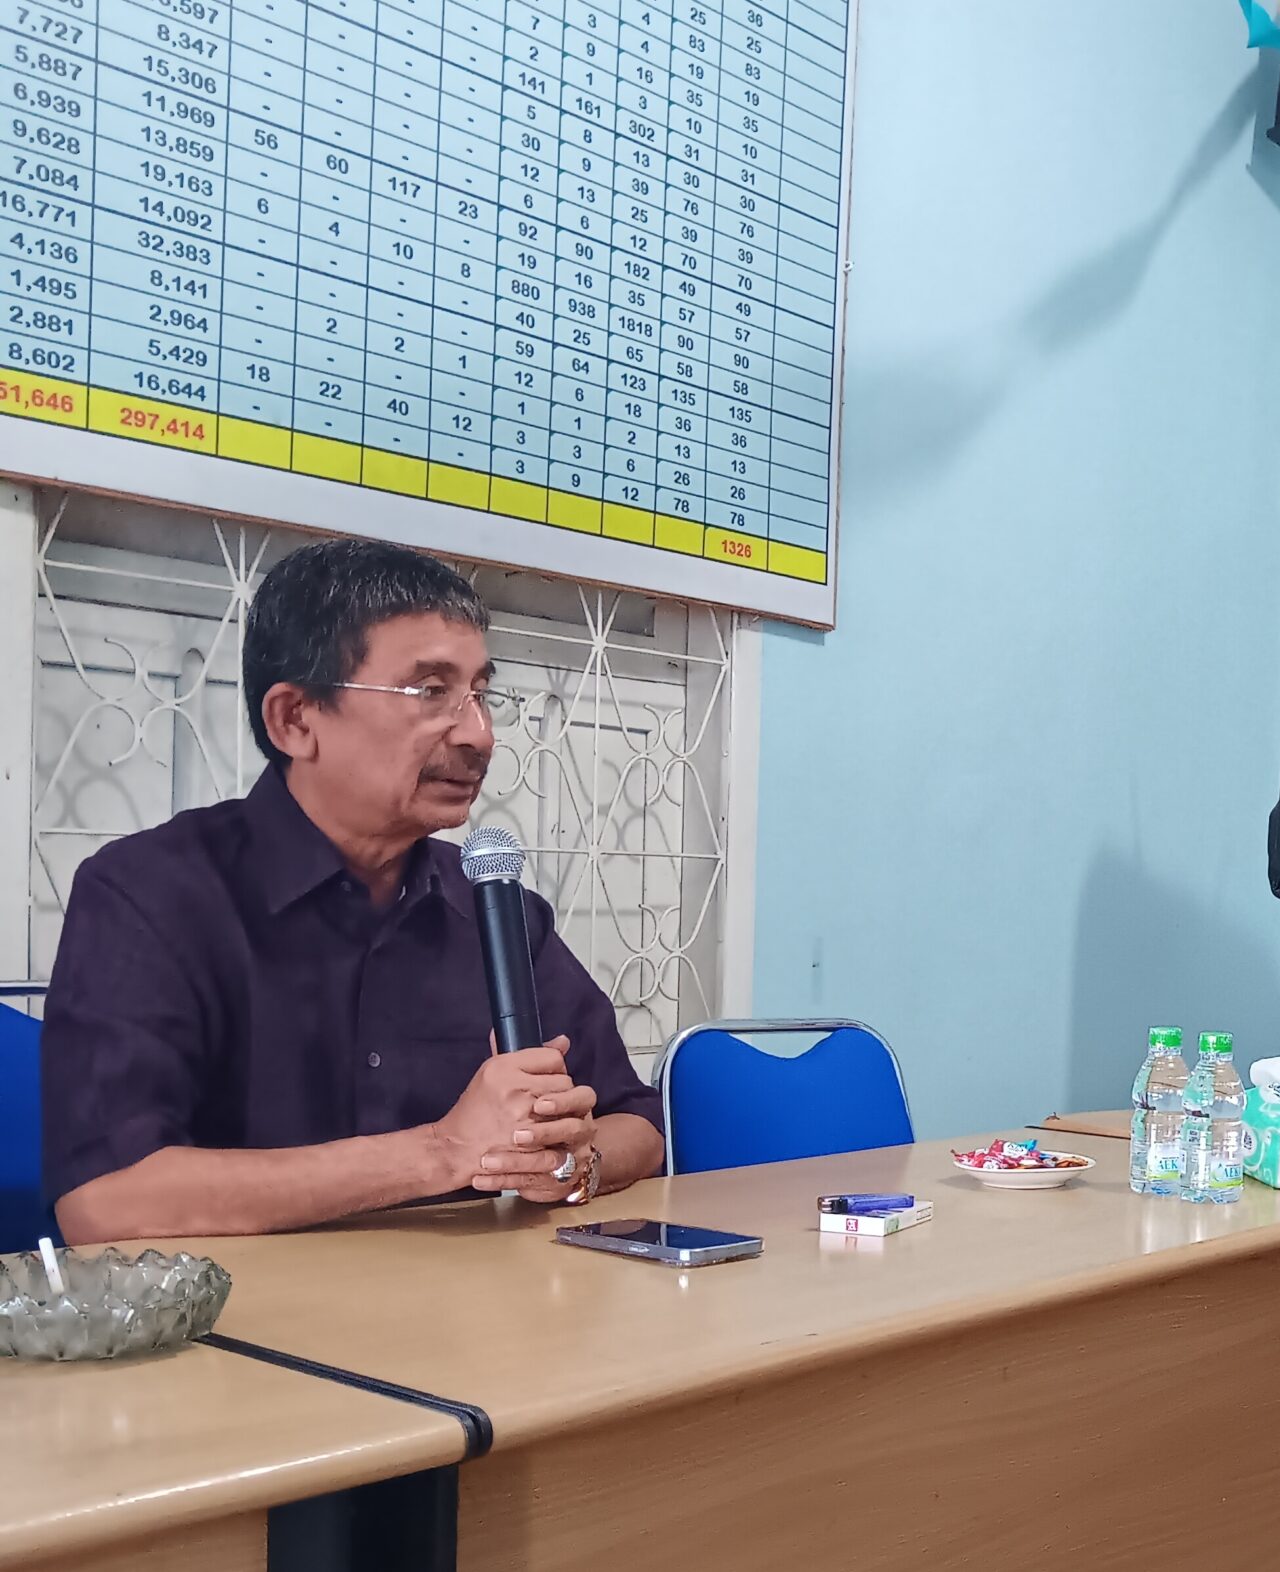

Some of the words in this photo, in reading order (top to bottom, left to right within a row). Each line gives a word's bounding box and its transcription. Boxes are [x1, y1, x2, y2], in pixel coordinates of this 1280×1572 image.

[529, 45, 539, 62] 2
[585, 71, 593, 87] 1
[638, 95, 648, 110] 3
[685, 117, 703, 135] 10
[741, 143, 758, 160] 10
[531, 15, 541, 31] 7
[586, 41, 596, 58] 9
[636, 66, 654, 84] 16
[686, 88, 704, 108] 35
[742, 115, 759, 133] 35
[587, 13, 597, 29] 3
[640, 40, 650, 54] 4
[688, 62, 705, 80] 19
[744, 90, 760, 107] 19
[641, 12, 651, 26] 4
[688, 33, 706, 53] 83
[744, 62, 761, 81] 83
[690, 6, 707, 26] 25
[746, 36, 762, 54] 25
[747, 9, 764, 28] 36
[13, 82, 81, 118] 6,939
[140, 125, 215, 163] 13,859
[517, 252, 537, 270] 19
[574, 271, 593, 290] 16
[627, 289, 646, 307] 35
[678, 306, 696, 324] 57
[734, 326, 751, 343] 57
[14, 44, 83, 81] 5,887
[141, 90, 216, 129] 11,969
[253, 128, 279, 151] 56
[325, 153, 349, 175] 60
[387, 176, 421, 199] 117
[457, 200, 479, 220] 23
[518, 221, 538, 242] 92
[575, 242, 594, 261] 90
[624, 260, 650, 282] 182
[678, 280, 696, 297] 49
[735, 301, 752, 317] 49
[16, 6, 84, 45] 7,727
[142, 55, 217, 95] 15,306
[523, 193, 534, 209] 6
[580, 215, 590, 230] 6
[629, 234, 648, 253] 12
[680, 252, 698, 271] 70
[737, 273, 753, 291] 70
[156, 23, 219, 59] 8,347
[520, 163, 540, 183] 12
[577, 185, 596, 204] 13
[630, 205, 649, 224] 25
[681, 225, 698, 243] 39
[737, 247, 754, 265] 39
[518, 71, 546, 95] 141
[575, 96, 601, 119] 161
[628, 119, 656, 143] 302
[683, 143, 700, 162] 31
[740, 168, 755, 186] 31
[520, 132, 541, 152] 30
[581, 157, 592, 173] 9
[631, 177, 650, 196] 39
[682, 197, 699, 216] 76
[739, 221, 755, 239] 76
[526, 104, 537, 121] 5
[582, 128, 593, 144] 8
[632, 150, 651, 168] 13
[683, 171, 700, 189] 30
[739, 194, 756, 213] 30
[0, 190, 76, 228] 16,771
[137, 230, 212, 266] 32,383
[515, 340, 535, 359] 59
[571, 357, 590, 375] 64
[620, 372, 647, 392] 123
[671, 388, 696, 407] 135
[728, 405, 753, 424] 135
[12, 118, 81, 155] 9,628
[139, 160, 214, 197] 19,163
[256, 197, 269, 215] 6
[327, 221, 341, 238] 4
[392, 241, 414, 260] 10
[460, 262, 471, 279] 8
[510, 279, 541, 301] 880
[567, 298, 596, 319] 938
[618, 315, 653, 338] 1818
[677, 334, 694, 352] 90
[733, 353, 750, 370] 90
[12, 155, 80, 192] 7,084
[138, 196, 213, 233] 14,092
[515, 311, 536, 329] 40
[572, 328, 591, 347] 25
[625, 345, 644, 363] 65
[676, 361, 693, 379] 58
[732, 379, 749, 396] 58
[9, 232, 79, 264] 4,136
[149, 269, 208, 300] 8,141
[325, 317, 338, 335] 2
[394, 336, 405, 354] 2
[458, 354, 467, 370] 1
[513, 370, 534, 389] 12
[574, 387, 585, 402] 6
[624, 402, 642, 419] 18
[674, 416, 692, 433] 36
[731, 432, 747, 449] 36
[9, 305, 73, 337] 2,881
[147, 338, 208, 368] 5,429
[246, 363, 271, 383] 18
[318, 380, 342, 401] 22
[386, 398, 410, 417] 40
[451, 414, 473, 433] 12
[515, 429, 526, 446] 3
[572, 444, 582, 460] 3
[626, 458, 636, 473] 6
[673, 470, 691, 487] 26
[730, 485, 746, 501] 26
[10, 268, 77, 300] 1,495
[148, 303, 209, 334] 2,964
[517, 401, 526, 416] 1
[573, 416, 582, 431] 1
[627, 430, 637, 446] 2
[674, 443, 691, 460] 13
[730, 459, 747, 475] 13
[8, 342, 75, 374] 8,602
[133, 371, 207, 402] 16,644
[515, 459, 525, 475] 3
[571, 473, 581, 488] 9
[621, 485, 640, 502] 12
[673, 497, 690, 514] 78
[729, 511, 745, 527] 78
[119, 407, 205, 441] 297,414
[721, 539, 752, 559] 1326
